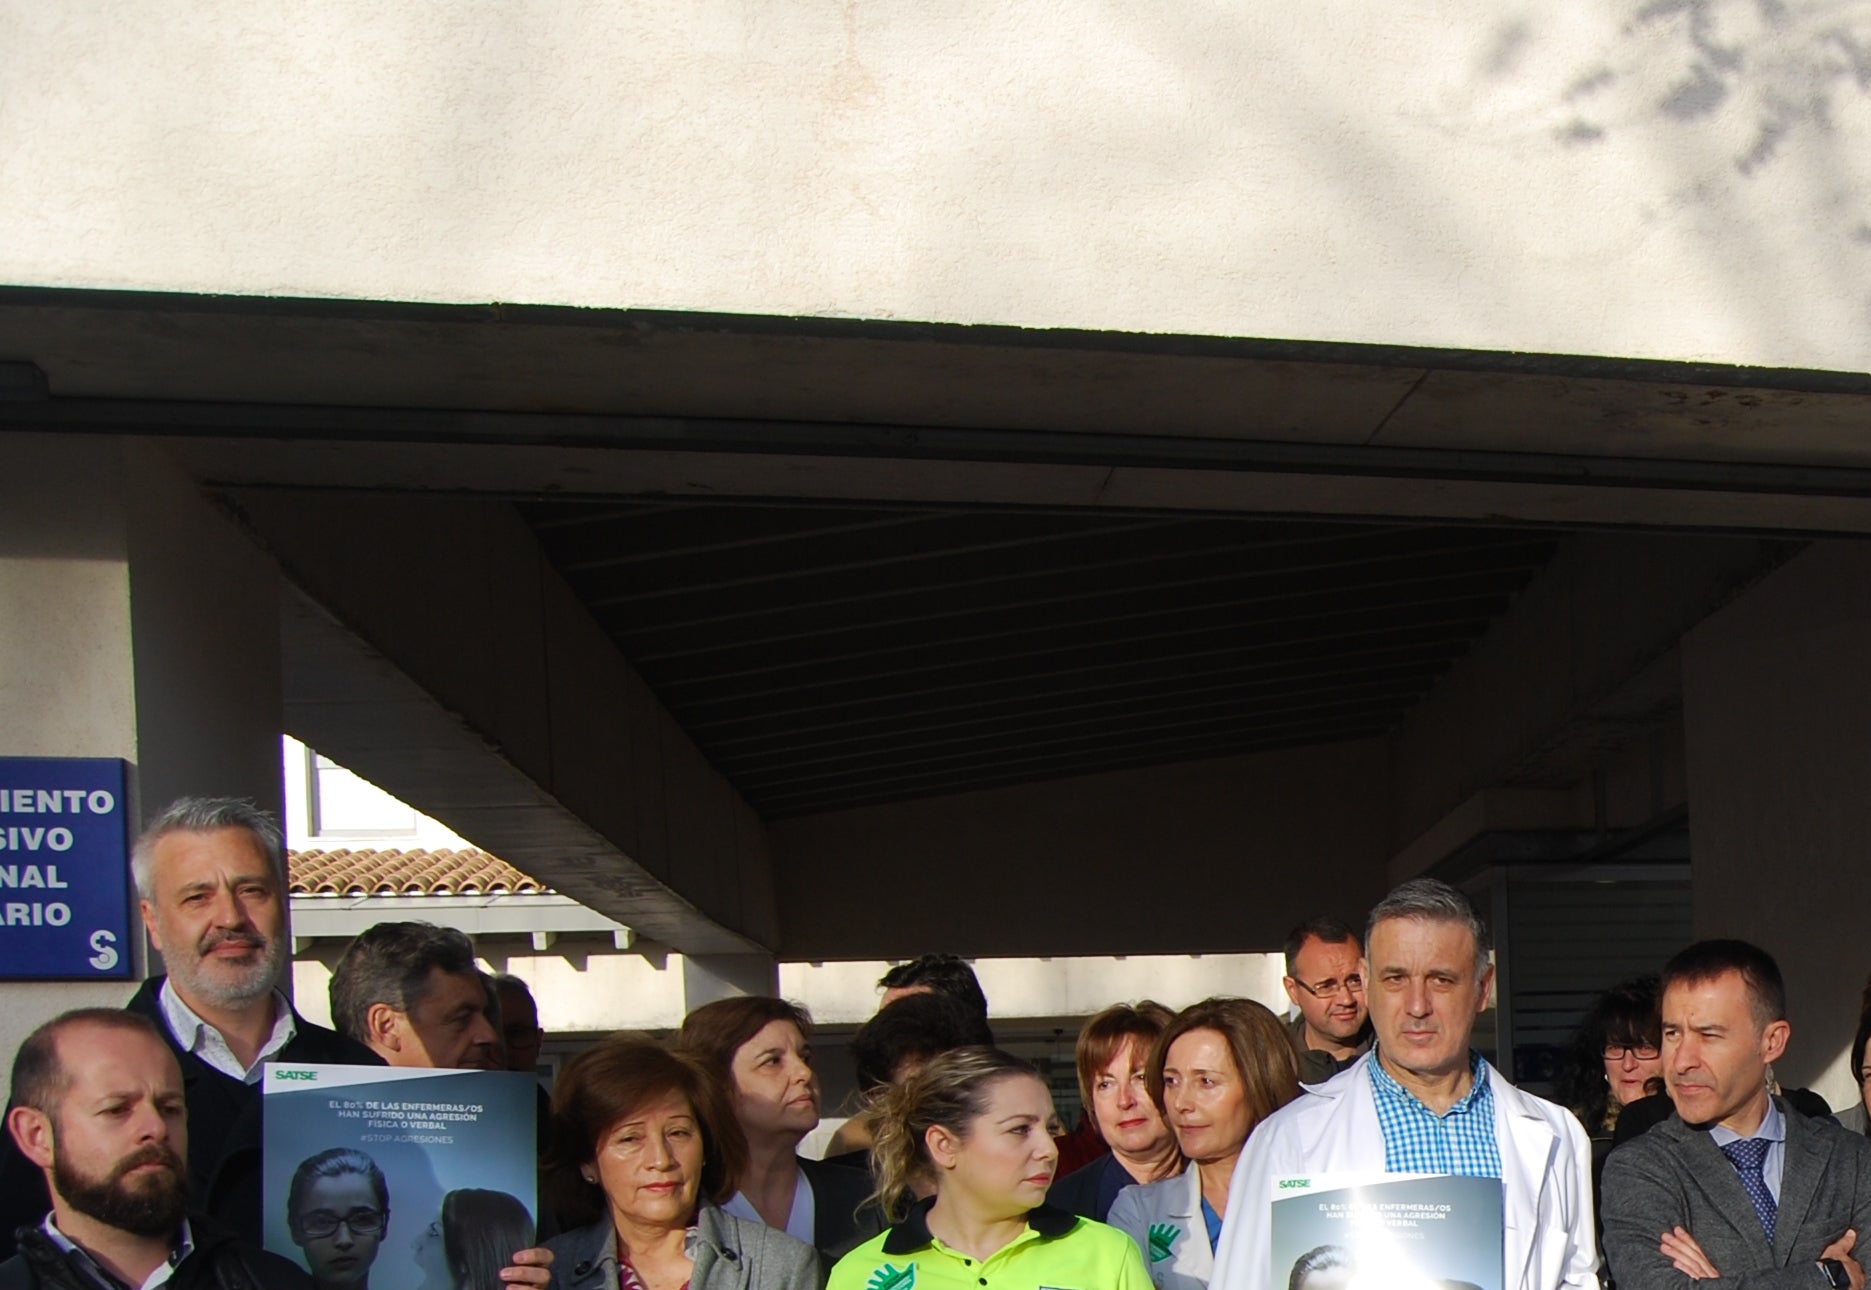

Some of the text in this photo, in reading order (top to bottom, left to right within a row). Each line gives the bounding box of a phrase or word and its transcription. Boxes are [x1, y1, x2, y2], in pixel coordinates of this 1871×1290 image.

[0, 902, 71, 926] RIO
[275, 1070, 318, 1080] SATSE
[380, 1101, 399, 1110] LAS
[401, 1102, 485, 1113] ENFERMERAS/OS
[336, 1109, 359, 1118] HAN
[361, 1109, 404, 1120] SUFRIDO
[406, 1111, 427, 1120] UNA
[410, 1121, 447, 1130] VERBAL
[1279, 1179, 1311, 1188] SATSE
